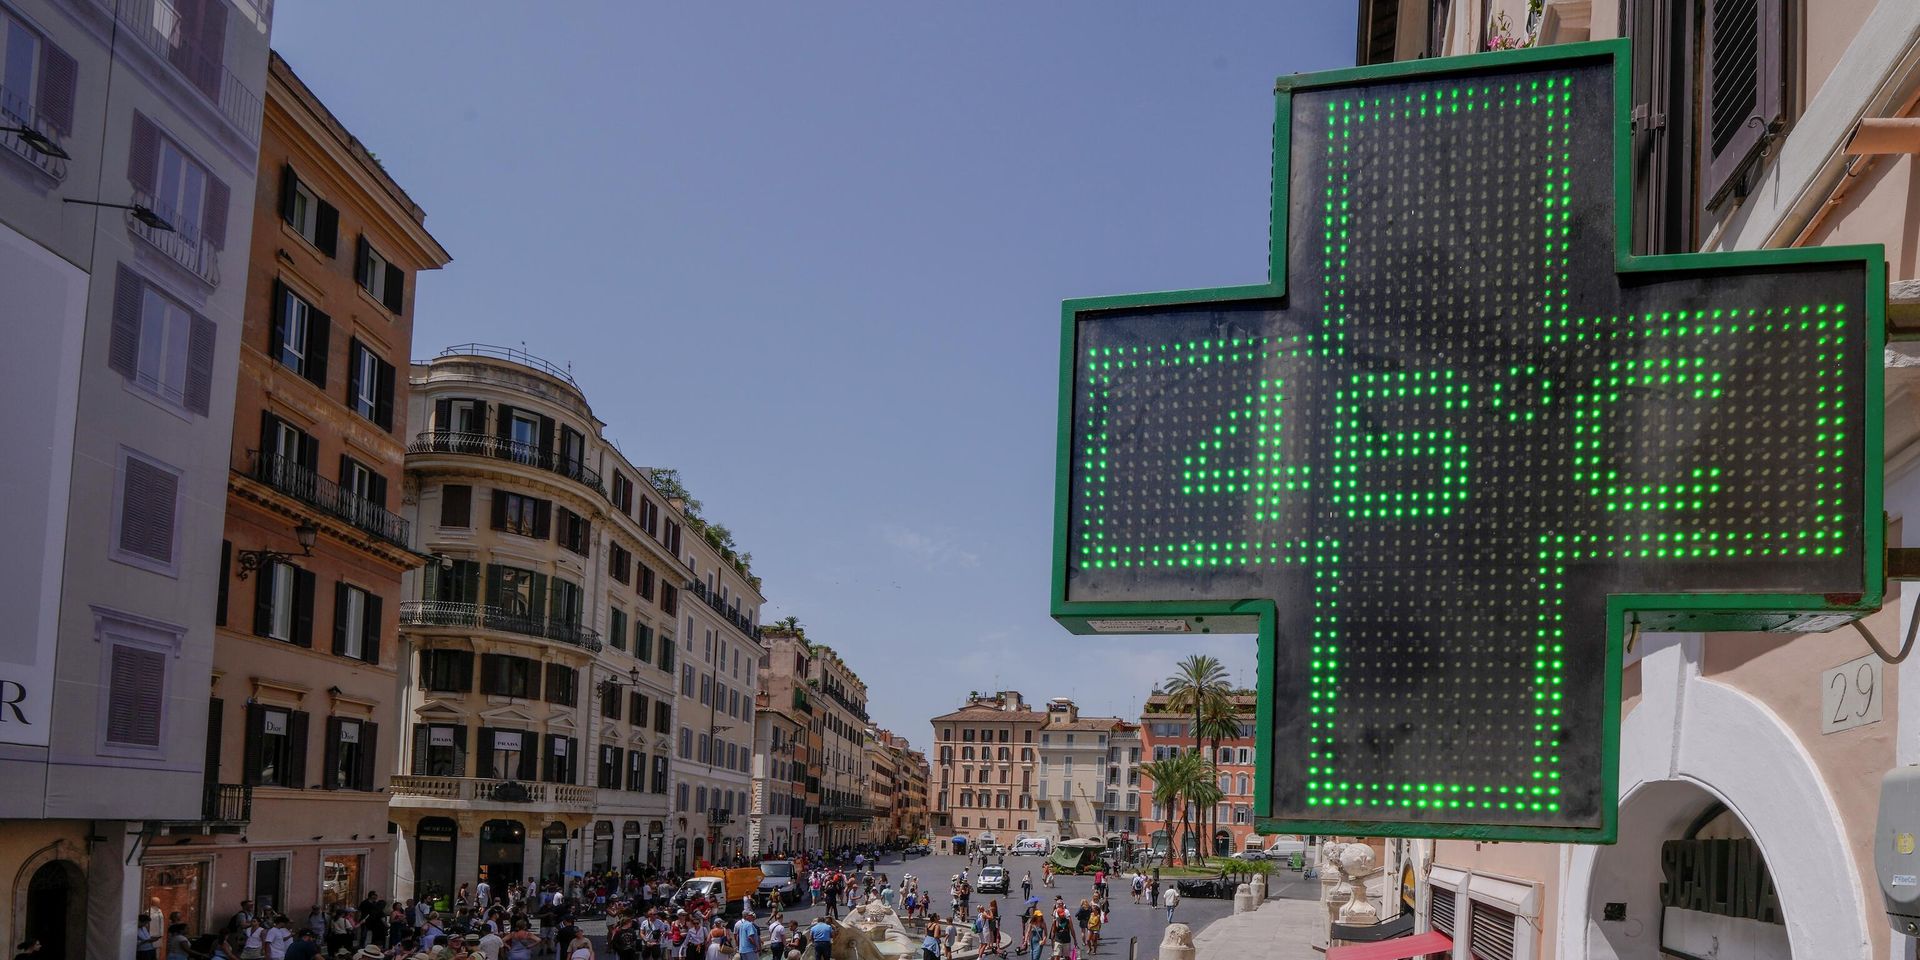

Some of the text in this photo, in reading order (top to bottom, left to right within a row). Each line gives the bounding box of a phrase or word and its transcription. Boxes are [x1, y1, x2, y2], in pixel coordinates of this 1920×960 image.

[1830, 663, 1874, 724] 29
[266, 720, 281, 732] Dior
[1024, 841, 1043, 849] FedEx
